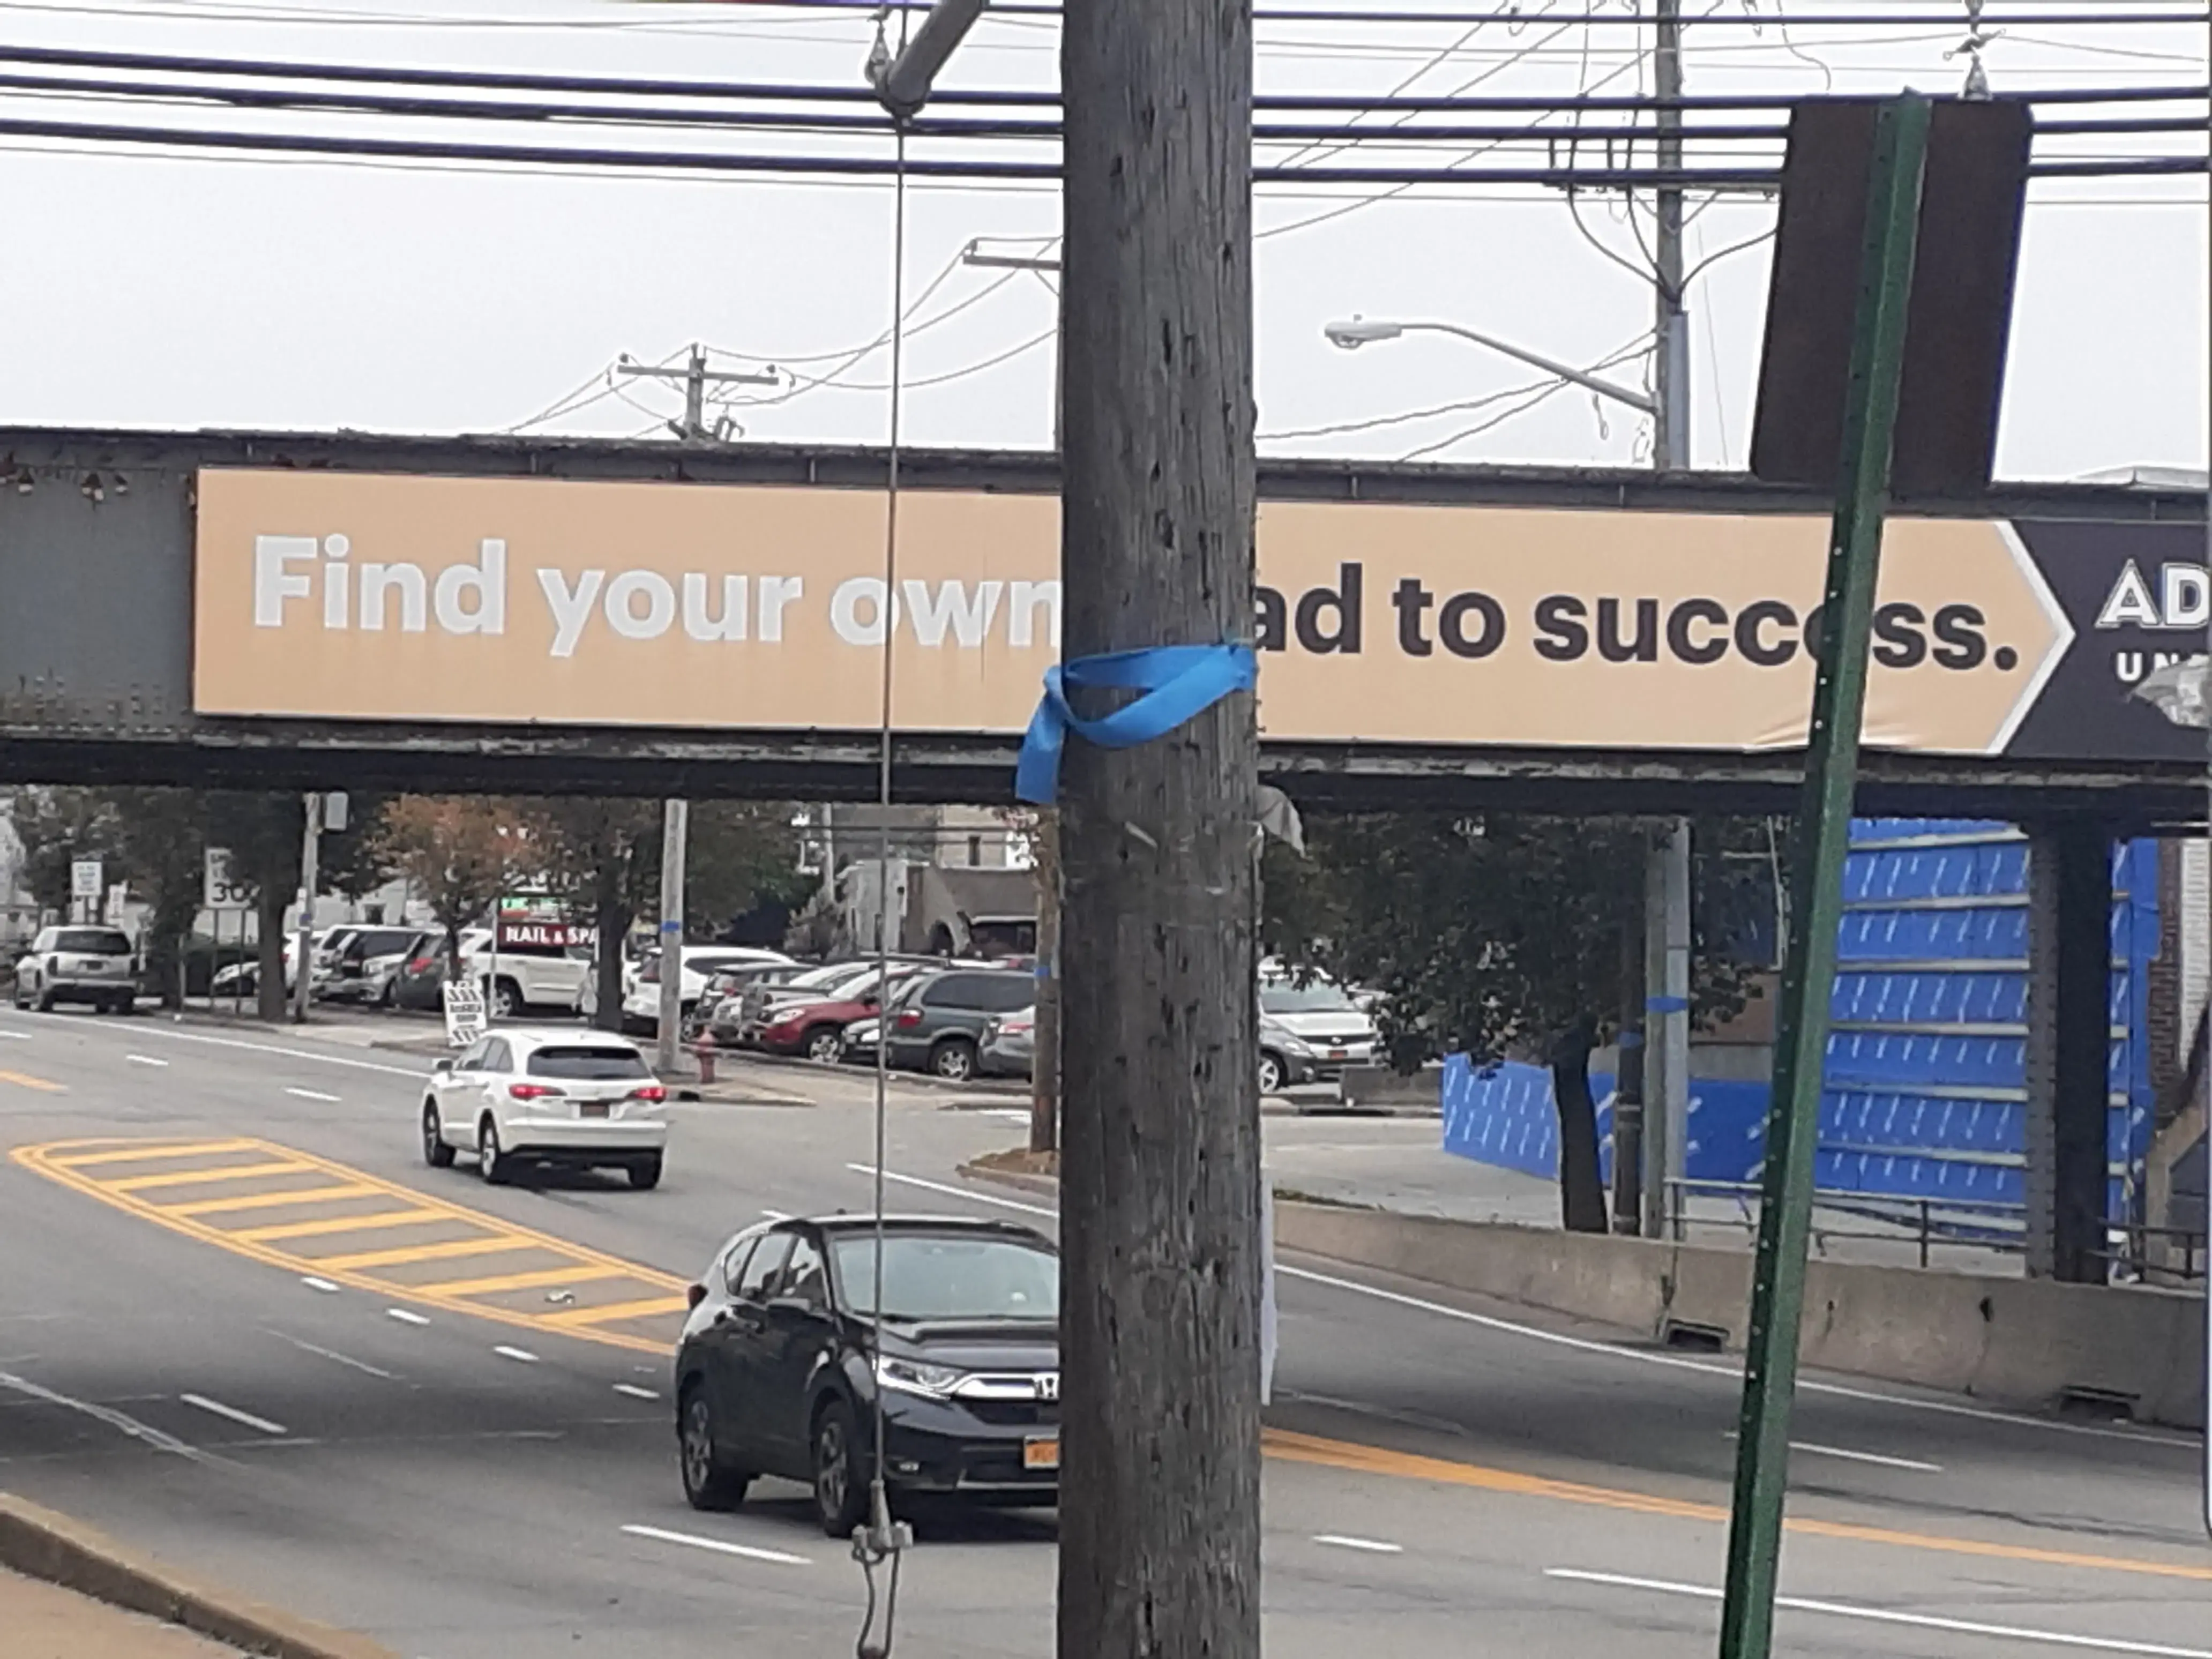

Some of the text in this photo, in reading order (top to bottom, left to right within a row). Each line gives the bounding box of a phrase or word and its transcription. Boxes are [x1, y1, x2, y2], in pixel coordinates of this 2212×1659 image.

[255, 533, 506, 634] Find
[536, 568, 804, 657] your
[829, 577, 1062, 647] own
[1392, 578, 1506, 659] to
[1533, 594, 2019, 671] succss.
[506, 926, 550, 944] NAIL
